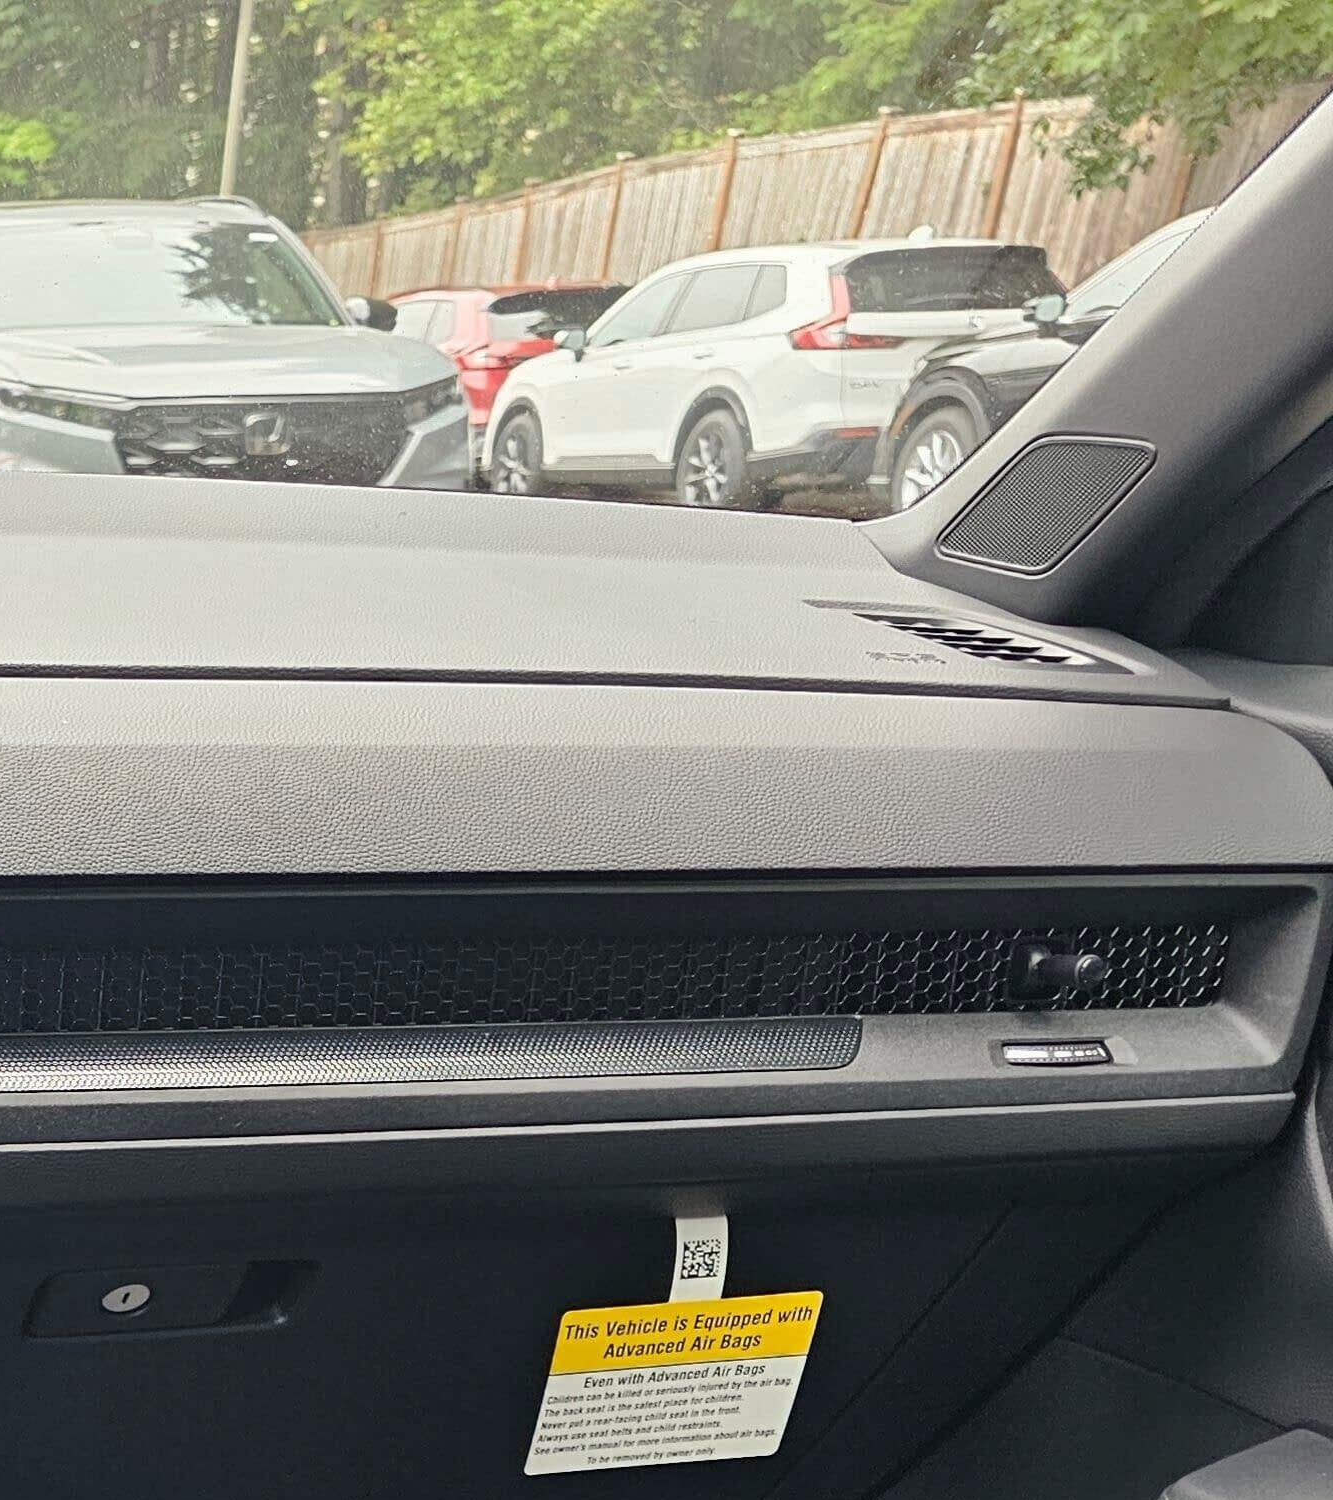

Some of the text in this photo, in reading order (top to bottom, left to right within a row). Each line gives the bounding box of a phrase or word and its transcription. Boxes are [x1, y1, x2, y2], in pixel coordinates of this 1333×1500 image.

[565, 1305, 814, 1341] This Vehicle is Equipped with
[602, 1333, 762, 1360] Advanced Air Bags
[583, 1364, 766, 1389] Even with Advanced Air Bags
[546, 1394, 584, 1406] Children
[586, 1393, 602, 1402] can
[604, 1391, 615, 1400] be
[617, 1388, 643, 1398] killed
[644, 1389, 654, 1397] or
[655, 1384, 695, 1396] seriously
[697, 1381, 729, 1393] injured
[731, 1380, 742, 1390] by
[743, 1379, 758, 1389] the
[759, 1378, 773, 1387] air
[540, 1420, 567, 1430] Never
[568, 1419, 584, 1429] put
[593, 1414, 643, 1426] rear-facing
[644, 1411, 667, 1422] child
[669, 1410, 689, 1420] seat
[690, 1408, 700, 1417] in
[701, 1407, 715, 1416] the
[544, 1408, 560, 1418] The
[562, 1407, 583, 1417] back
[586, 1405, 605, 1414] seat
[607, 1403, 615, 1412] is
[617, 1402, 632, 1411] the
[634, 1399, 662, 1410] safest
[663, 1398, 688, 1409] place
[690, 1396, 704, 1405] for
[533, 1446, 550, 1456] See
[552, 1443, 586, 1454] owner's
[587, 1440, 622, 1451] manual
[623, 1438, 635, 1447] for
[636, 1437, 660, 1446] more
[661, 1433, 712, 1444] information
[713, 1430, 739, 1440] about
[739, 1429, 753, 1438] air
[536, 1433, 569, 1444] Always
[570, 1432, 587, 1441] use
[588, 1429, 609, 1439] seat
[610, 1427, 633, 1437] belts
[634, 1425, 652, 1435] and
[653, 1423, 676, 1433] child
[587, 1456, 597, 1465] To
[598, 1455, 610, 1464] be
[612, 1452, 652, 1463] removed
[653, 1451, 663, 1460] by
[665, 1449, 694, 1458] owner
